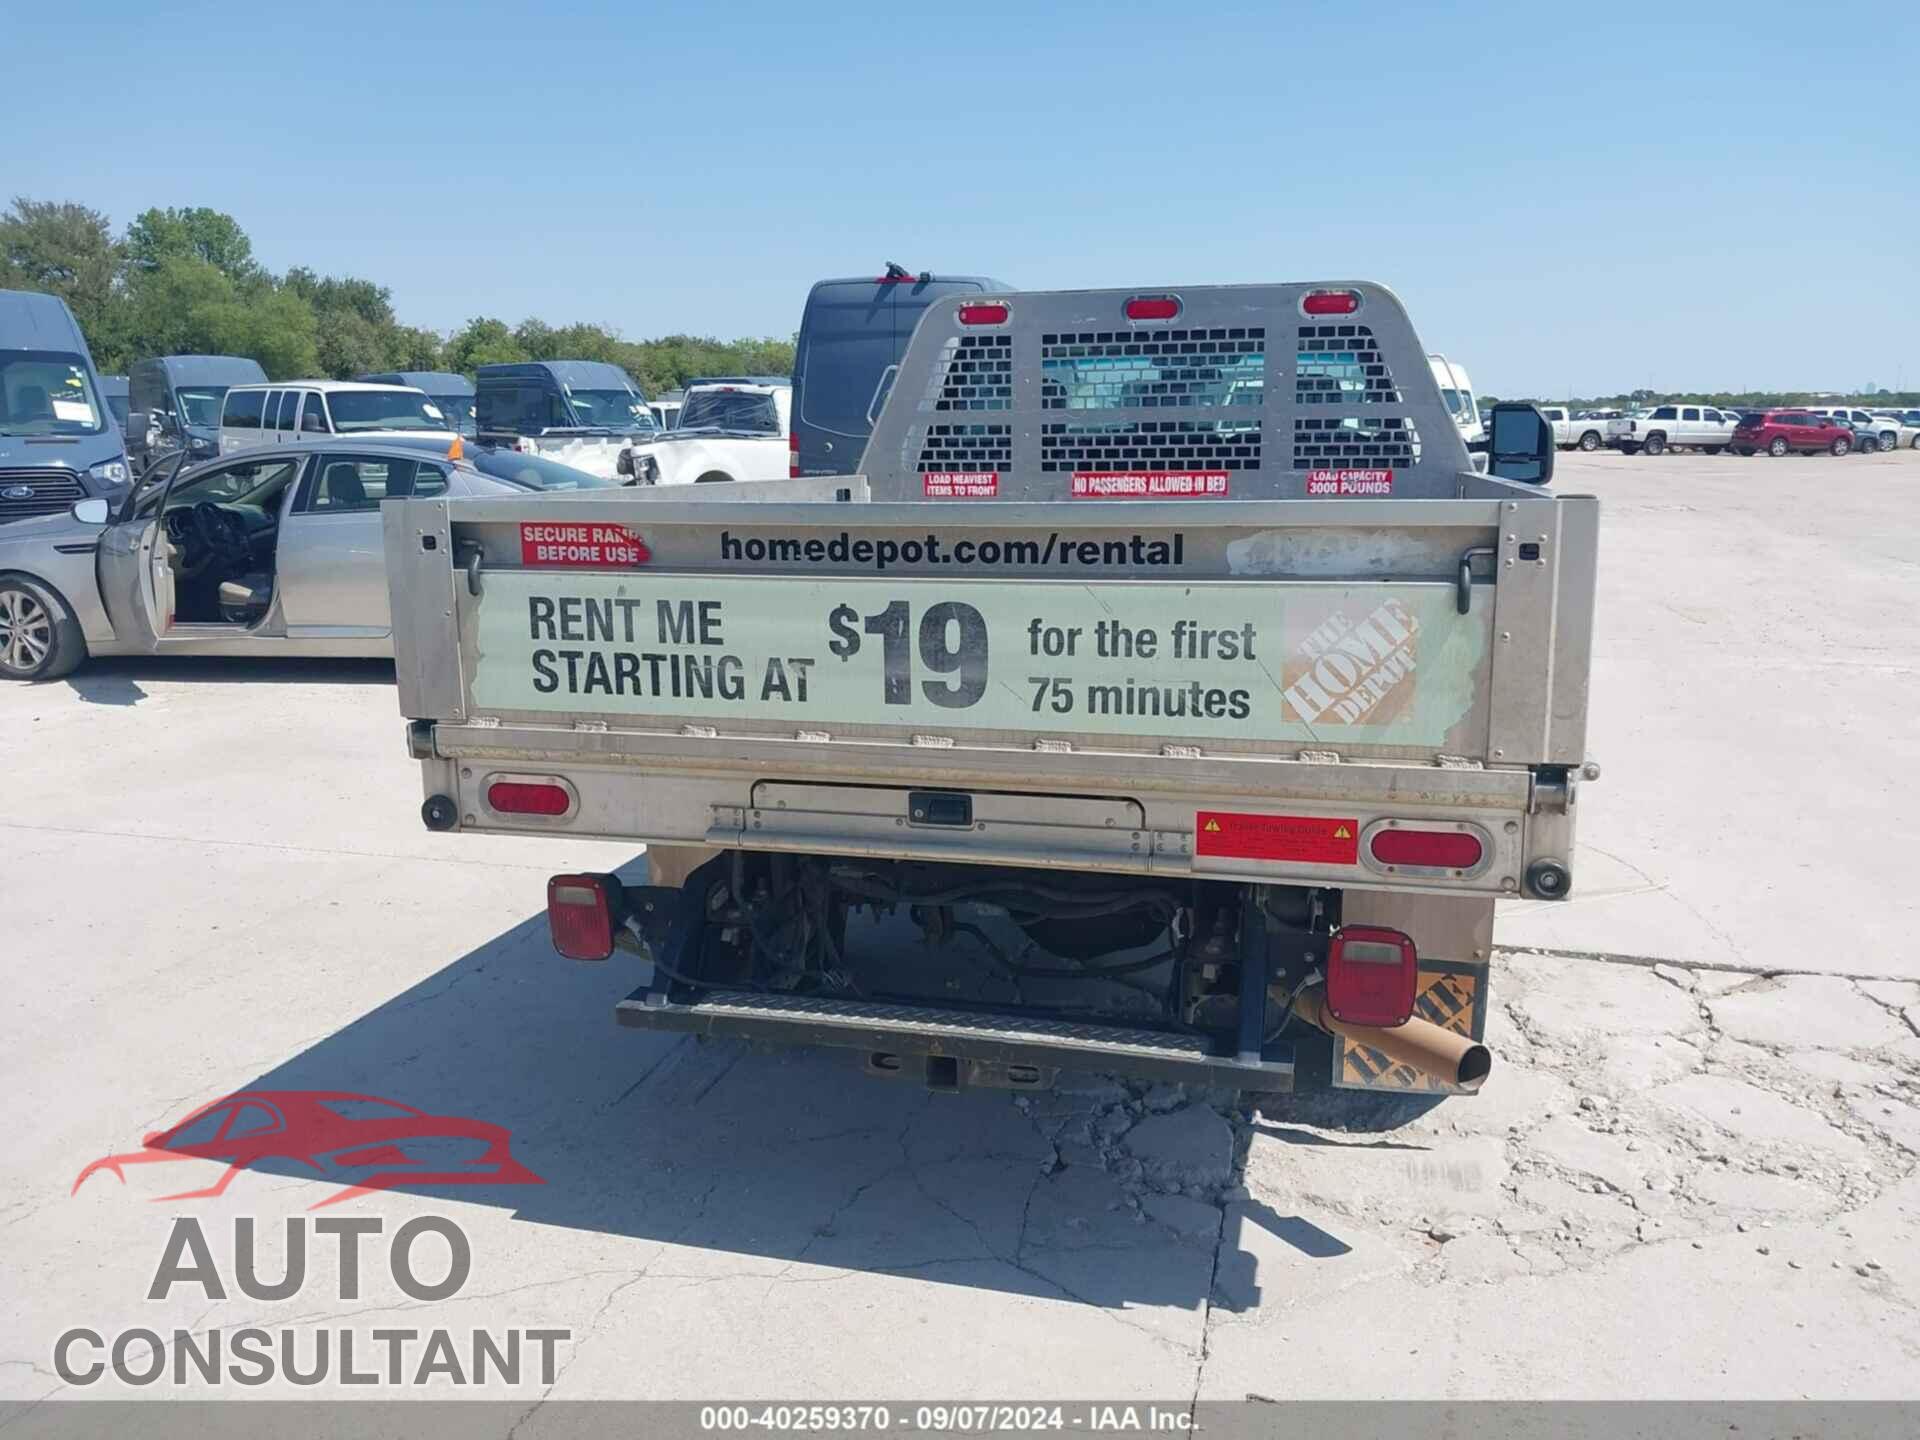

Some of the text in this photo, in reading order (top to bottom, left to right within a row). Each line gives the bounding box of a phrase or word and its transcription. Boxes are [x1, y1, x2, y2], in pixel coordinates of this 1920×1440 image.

[926, 485, 996, 496] ITEMS TO FRONT
[928, 474, 993, 485] LOAD HEAVIEST
[1074, 476, 1226, 493] NO PASSENGERS ALLOWED IN BED
[1309, 481, 1391, 494] 3000 POUNDS
[1312, 471, 1388, 481] LOAD CAPACITY
[523, 526, 587, 542] SECURE
[536, 545, 639, 562] BEFORE USE
[721, 531, 1184, 569] homedepot.com/rental
[528, 596, 724, 646] RENT ME
[1027, 617, 1257, 661] for the first
[1297, 609, 1355, 658] THE
[828, 599, 989, 709] $19
[1283, 598, 1420, 723] HOME
[532, 649, 815, 703] STARTING AT
[1332, 645, 1417, 725] DEPOT
[1028, 677, 1251, 720] 75 minutes
